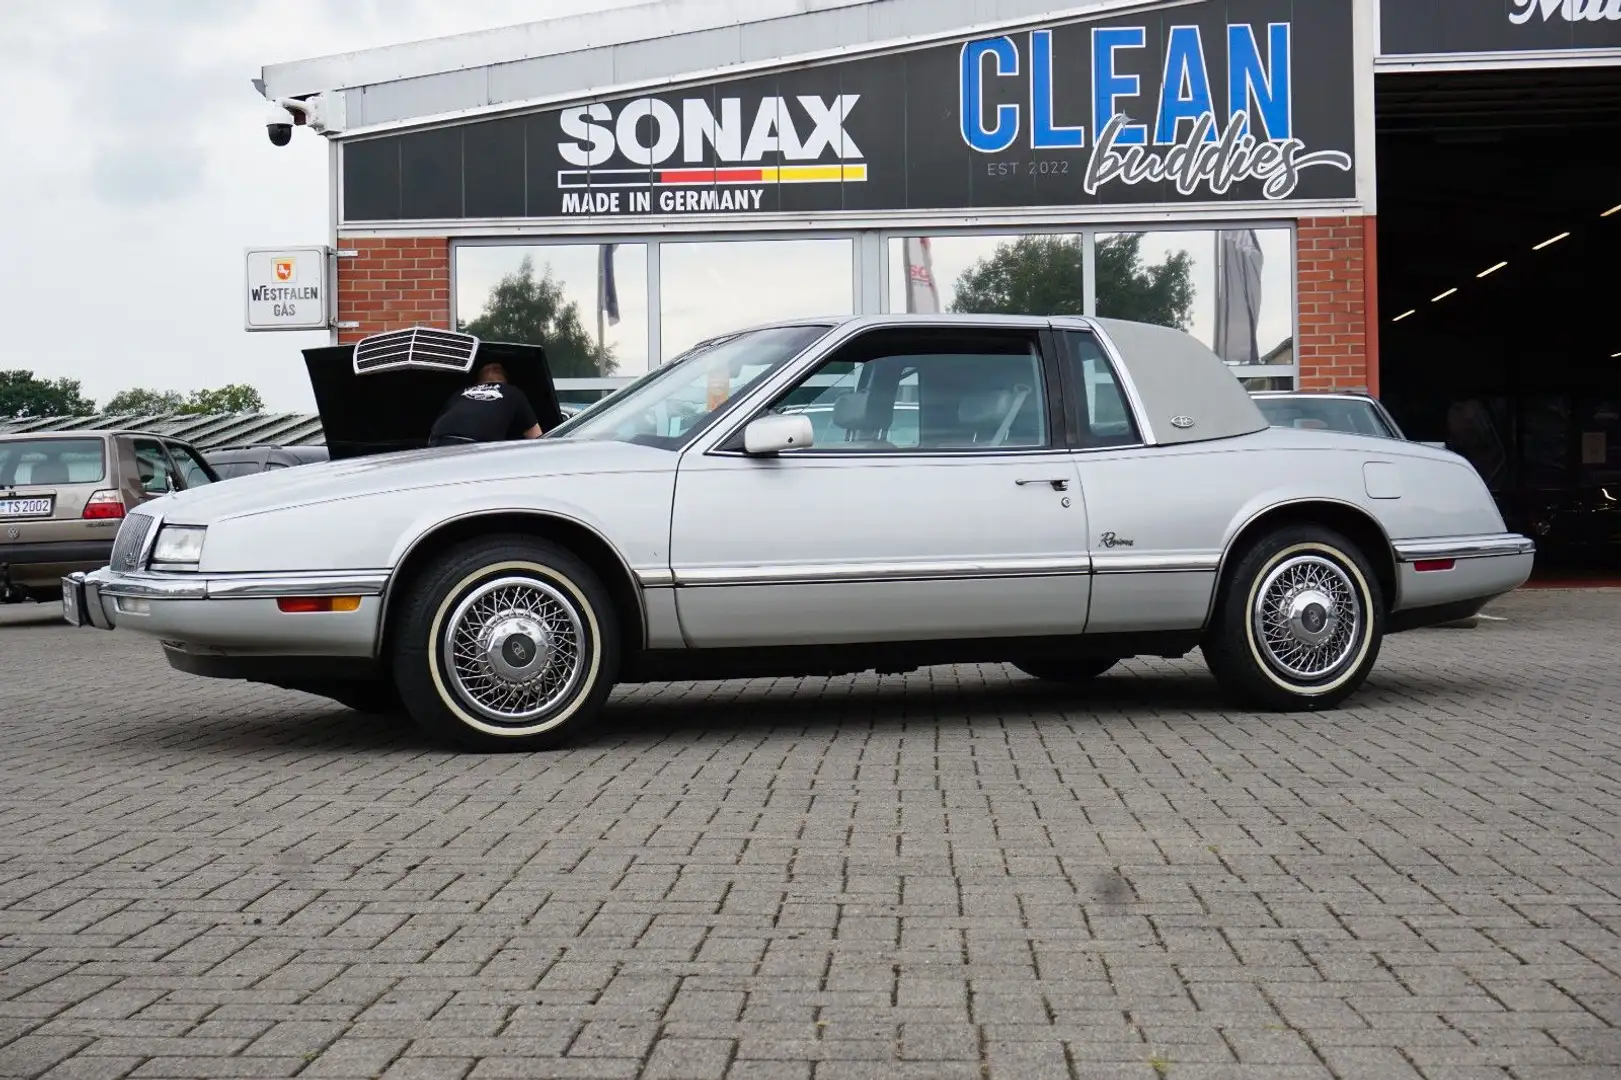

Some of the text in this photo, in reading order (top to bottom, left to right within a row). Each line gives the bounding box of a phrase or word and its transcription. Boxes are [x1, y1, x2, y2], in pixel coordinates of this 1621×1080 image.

[959, 22, 1292, 153] CLEAN
[557, 94, 865, 167] SONAX
[1083, 109, 1352, 200] buddies
[987, 161, 1069, 176] EST 2022
[561, 189, 764, 213] MADE IN GERMANY
[251, 285, 318, 301] WESTFALEN
[273, 302, 296, 317] GAS
[7, 500, 49, 513] TS 2002
